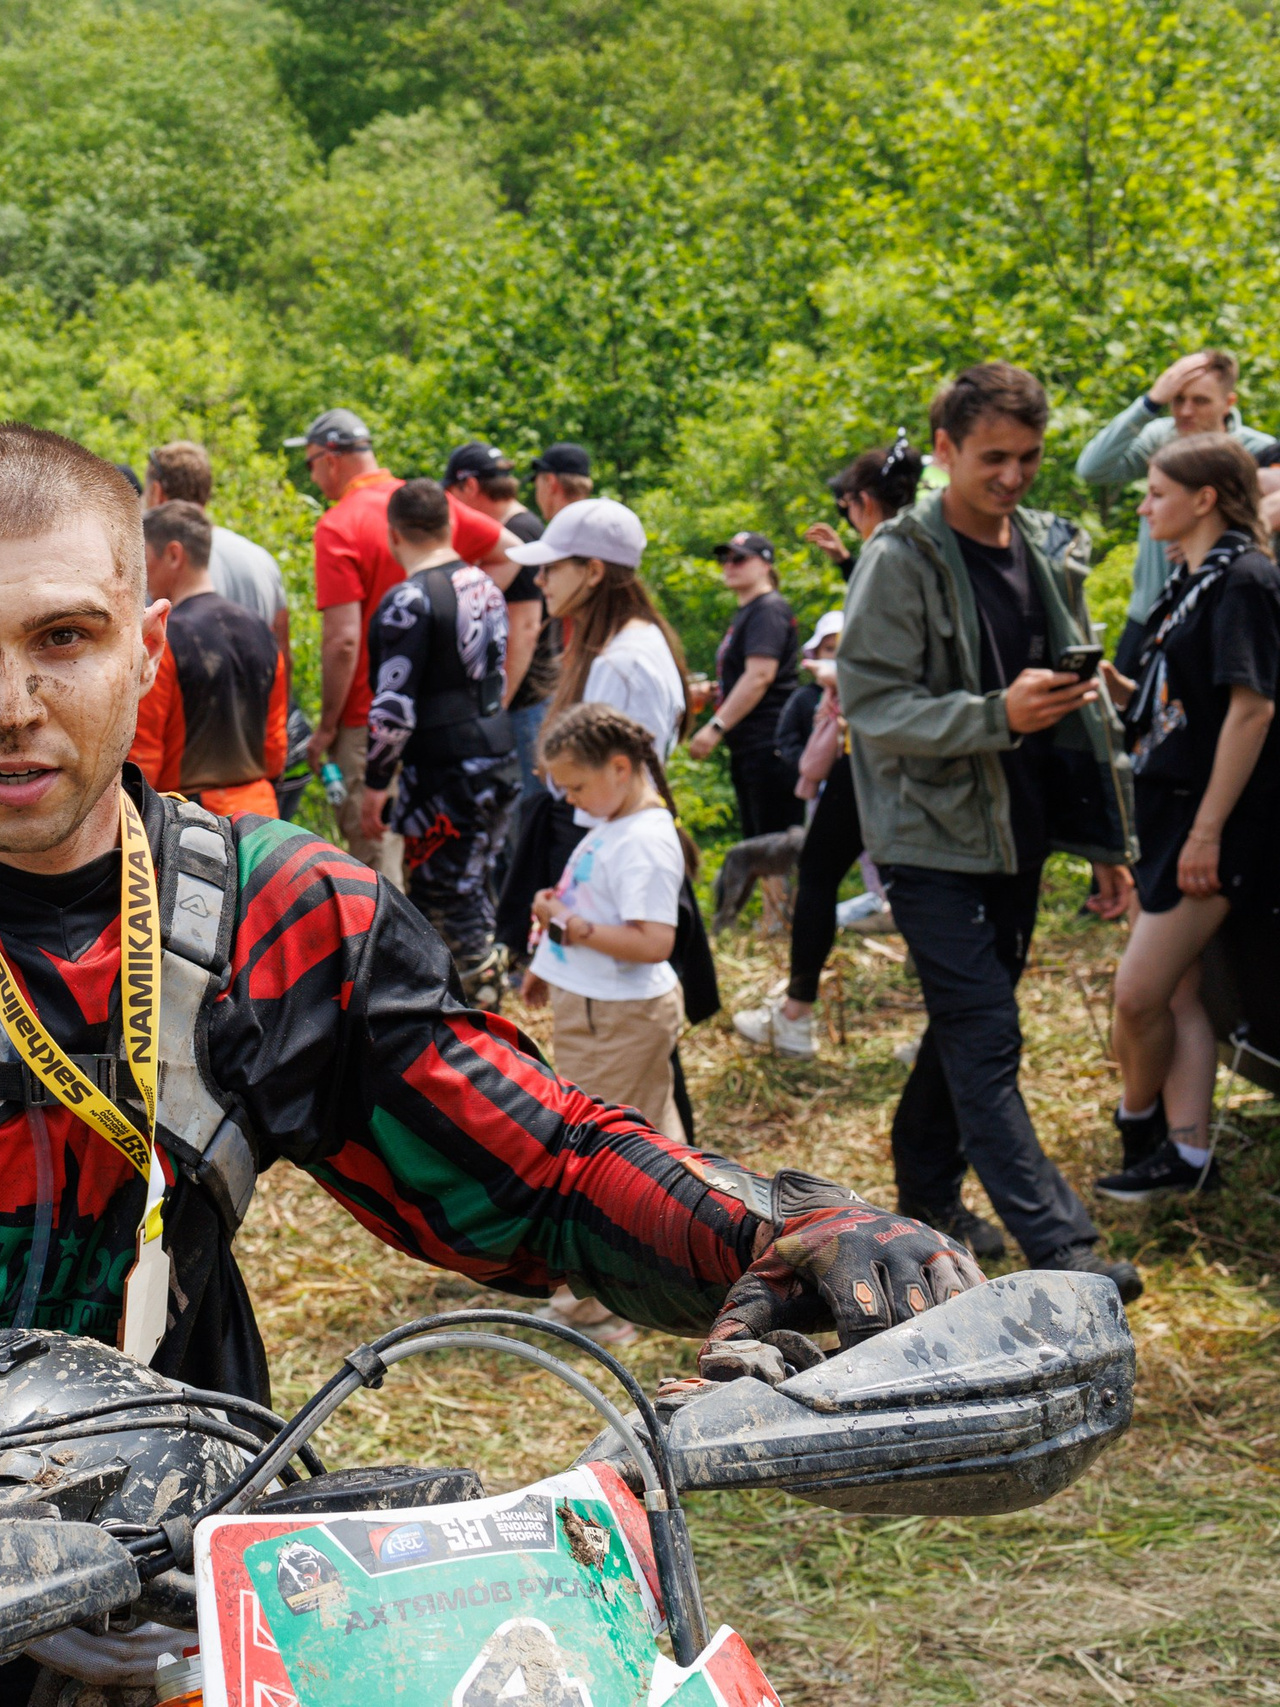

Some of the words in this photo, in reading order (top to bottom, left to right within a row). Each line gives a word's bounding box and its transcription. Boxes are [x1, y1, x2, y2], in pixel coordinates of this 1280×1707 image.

[127, 850, 152, 1064] NAMIKAWA
[89, 1109, 122, 1138] SAKHALIN
[99, 1110, 128, 1136] ENDURO
[104, 1109, 130, 1133] TROPHY
[493, 1511, 548, 1522] SAKHALIN
[495, 1520, 544, 1532] ENDURO
[500, 1530, 548, 1543] TROPHY
[344, 1580, 513, 1636] АХТЯМОВ
[517, 1576, 602, 1600] РУСЛА
